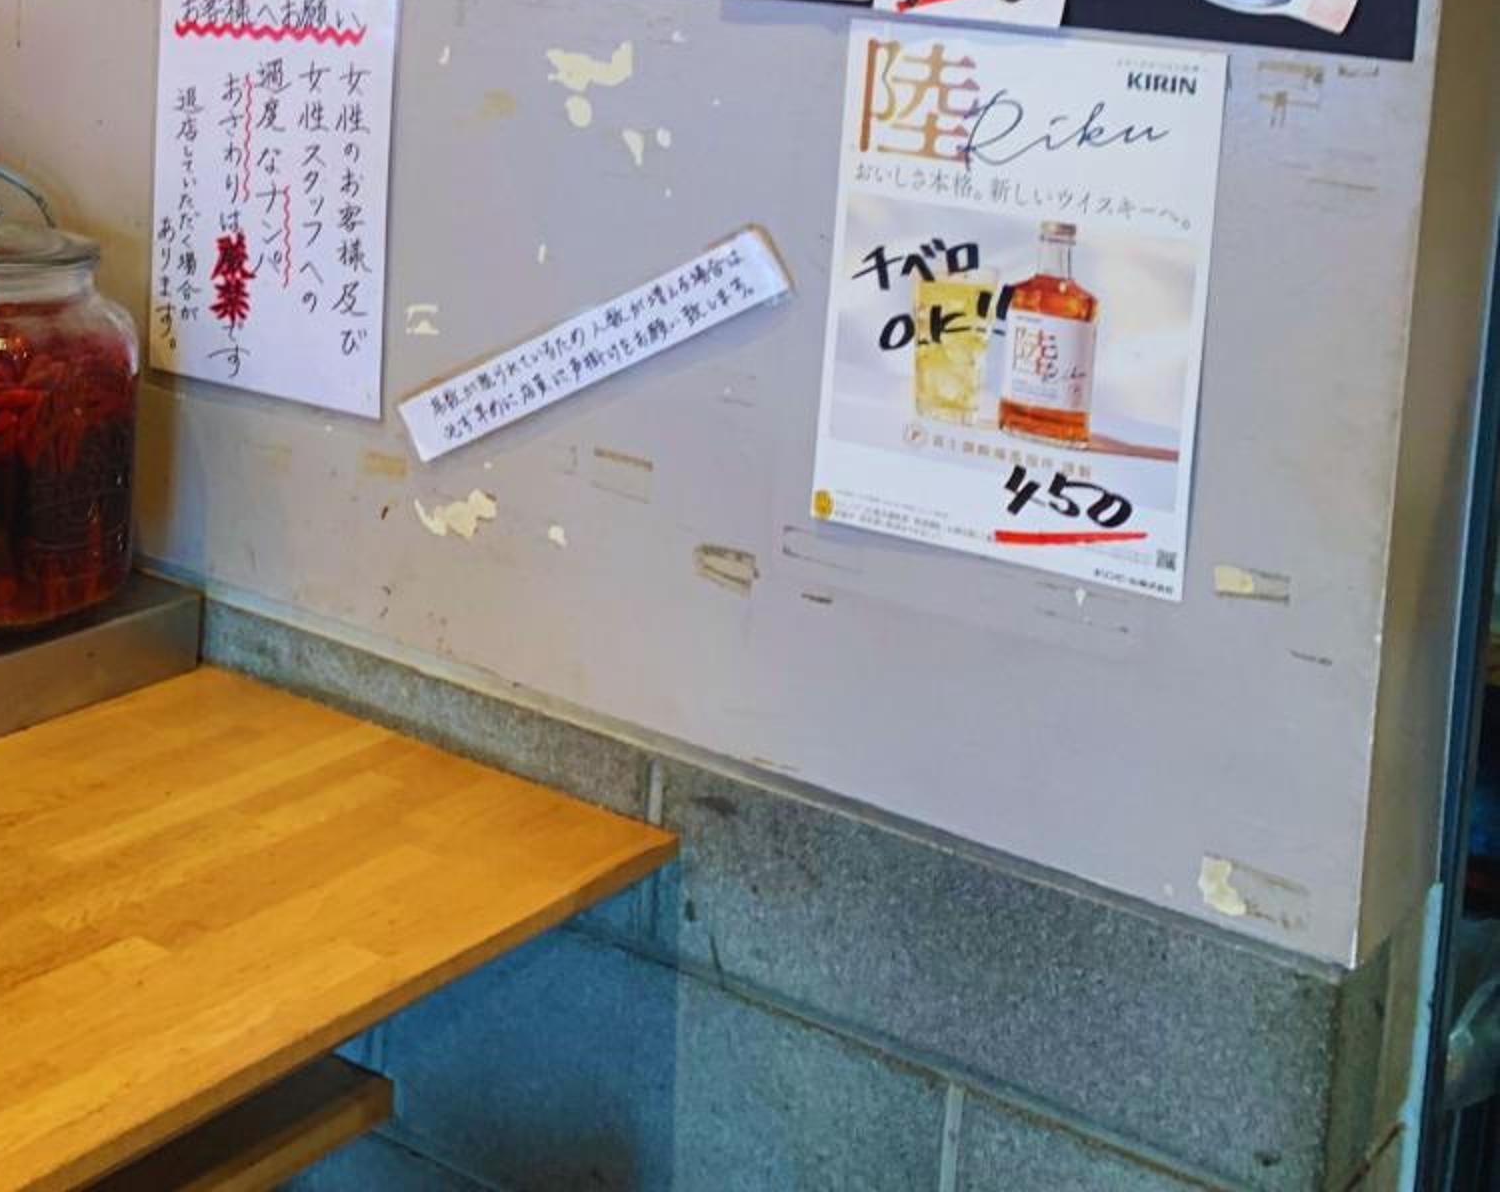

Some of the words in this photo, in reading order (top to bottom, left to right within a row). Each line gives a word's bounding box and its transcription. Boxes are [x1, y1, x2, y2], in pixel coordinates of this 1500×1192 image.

[858, 36, 982, 163] 陸
[1126, 71, 1198, 96] KIRIN
[298, 59, 332, 312] 女性スタッフへの
[333, 61, 373, 355] 女性のお客様及び
[1004, 464, 1133, 529] 450
